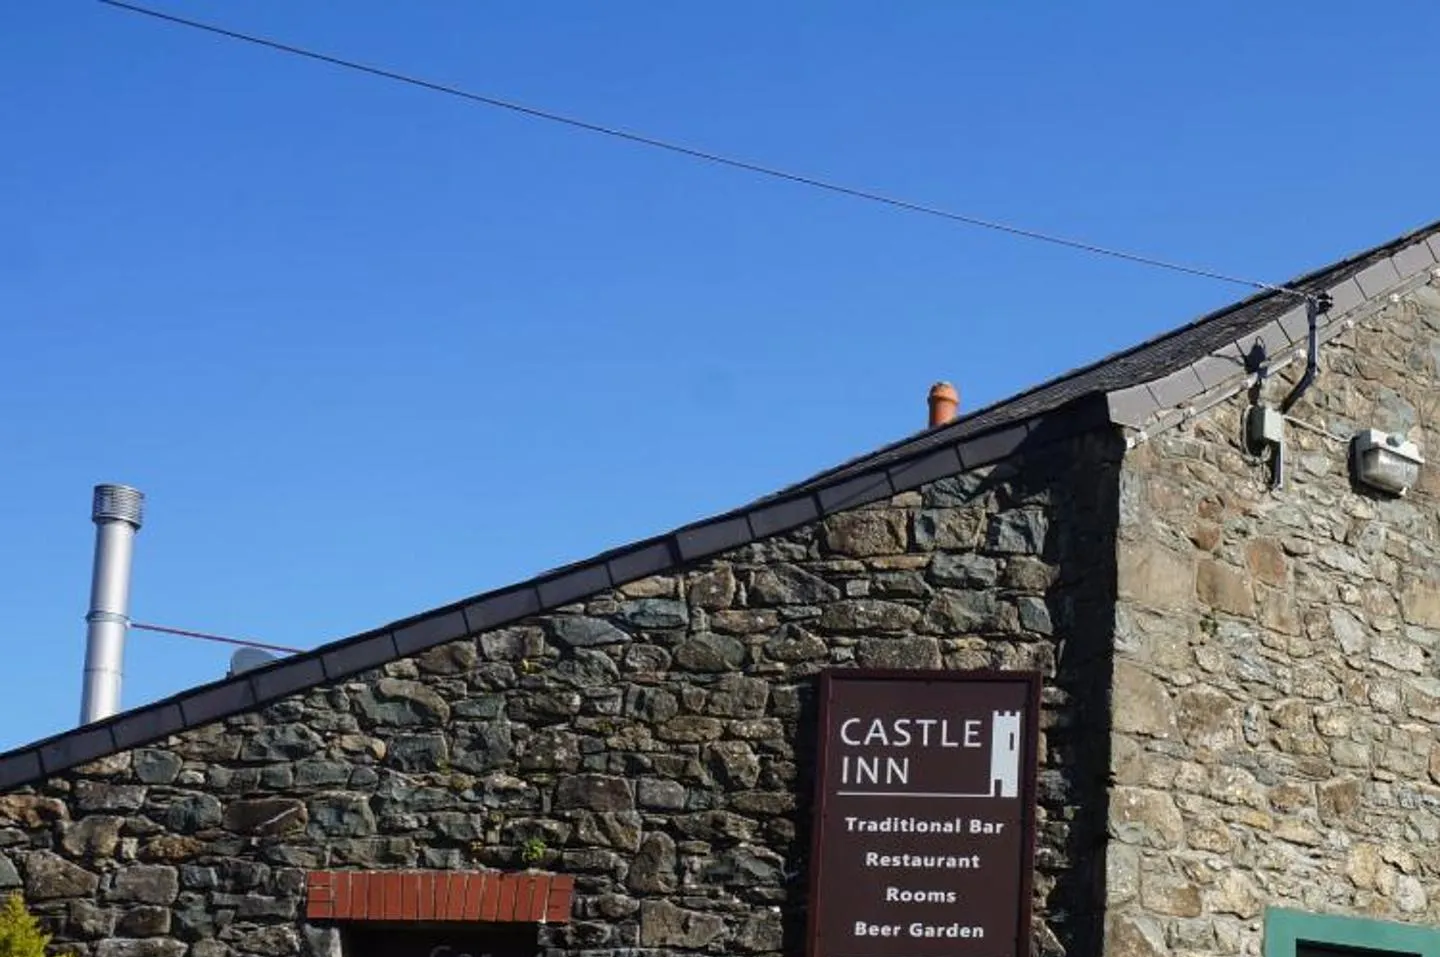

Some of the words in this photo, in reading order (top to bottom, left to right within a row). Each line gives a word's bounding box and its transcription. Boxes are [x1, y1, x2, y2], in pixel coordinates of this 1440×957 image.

[840, 717, 982, 748] CASTLE
[841, 756, 909, 785] INN
[845, 816, 961, 834] Traditional
[969, 818, 1004, 835] Bar
[866, 851, 980, 869] Restaurant
[886, 887, 957, 903] Rooms
[854, 921, 902, 937] Beer
[909, 922, 985, 939] Garden
